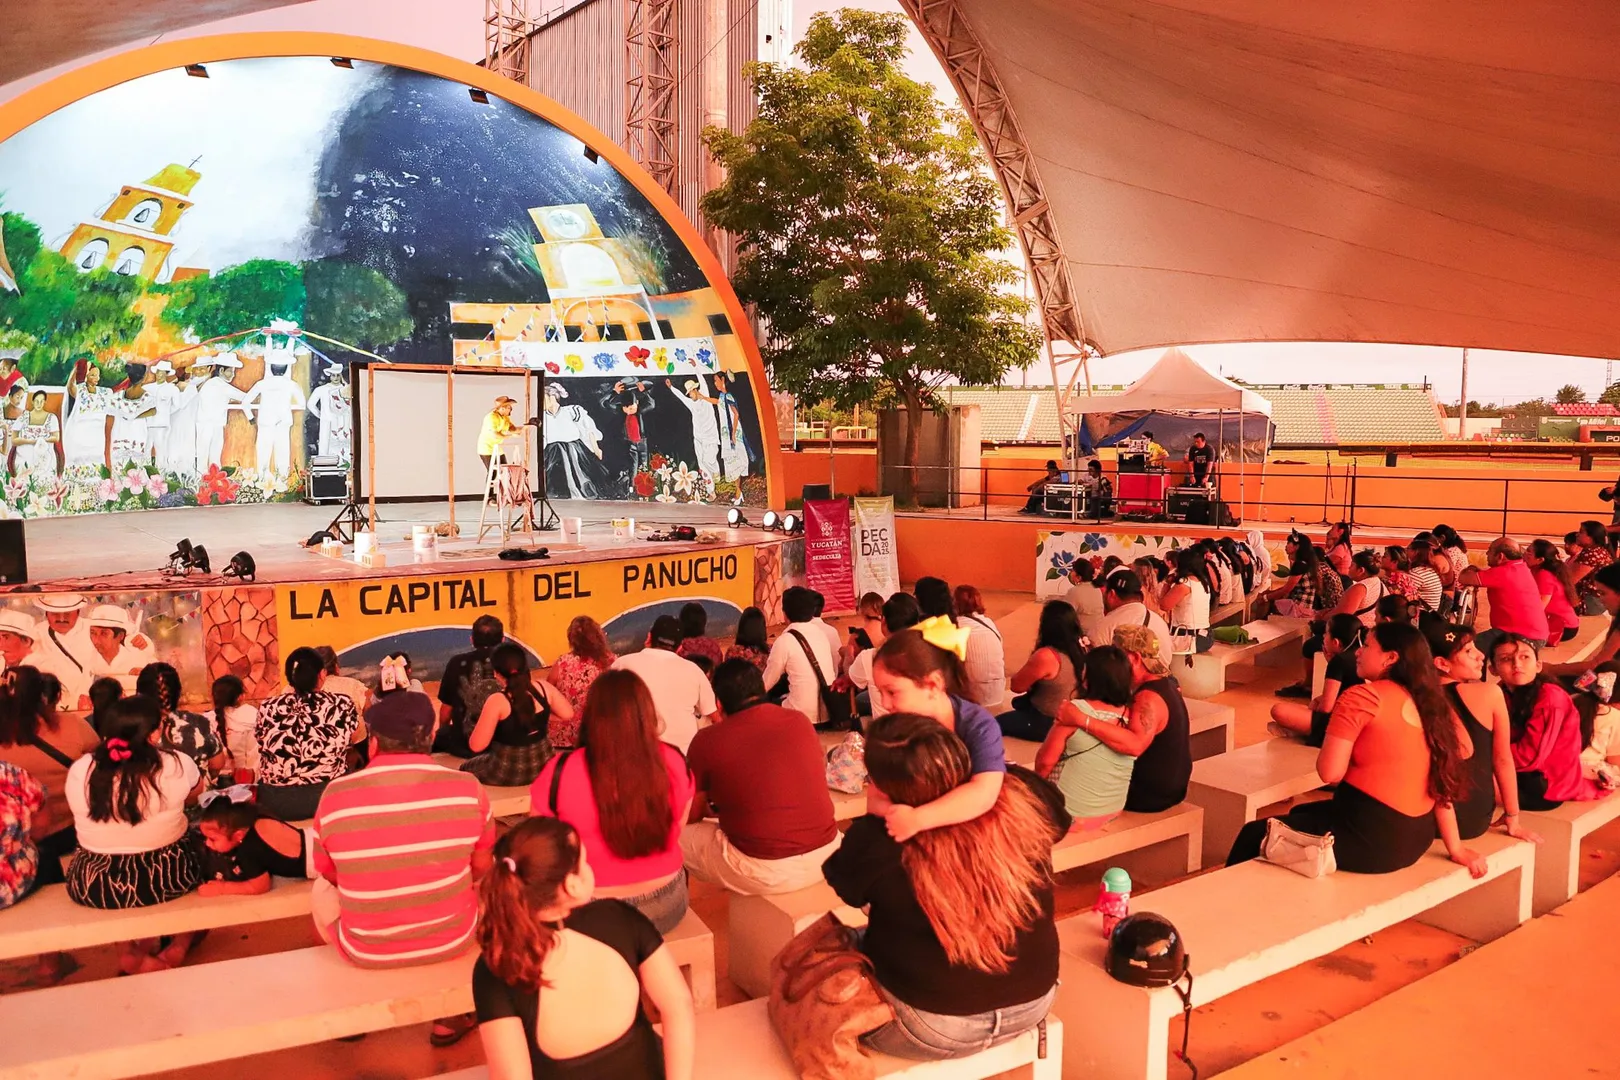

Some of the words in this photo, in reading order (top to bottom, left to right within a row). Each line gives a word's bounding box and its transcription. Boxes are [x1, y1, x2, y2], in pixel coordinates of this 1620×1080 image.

[861, 528, 888, 543] PEC
[861, 542, 881, 556] DA
[289, 588, 339, 620] LA
[359, 578, 497, 616] CAPITAL
[534, 570, 591, 602] DEL
[623, 554, 738, 593] PANUCHO
